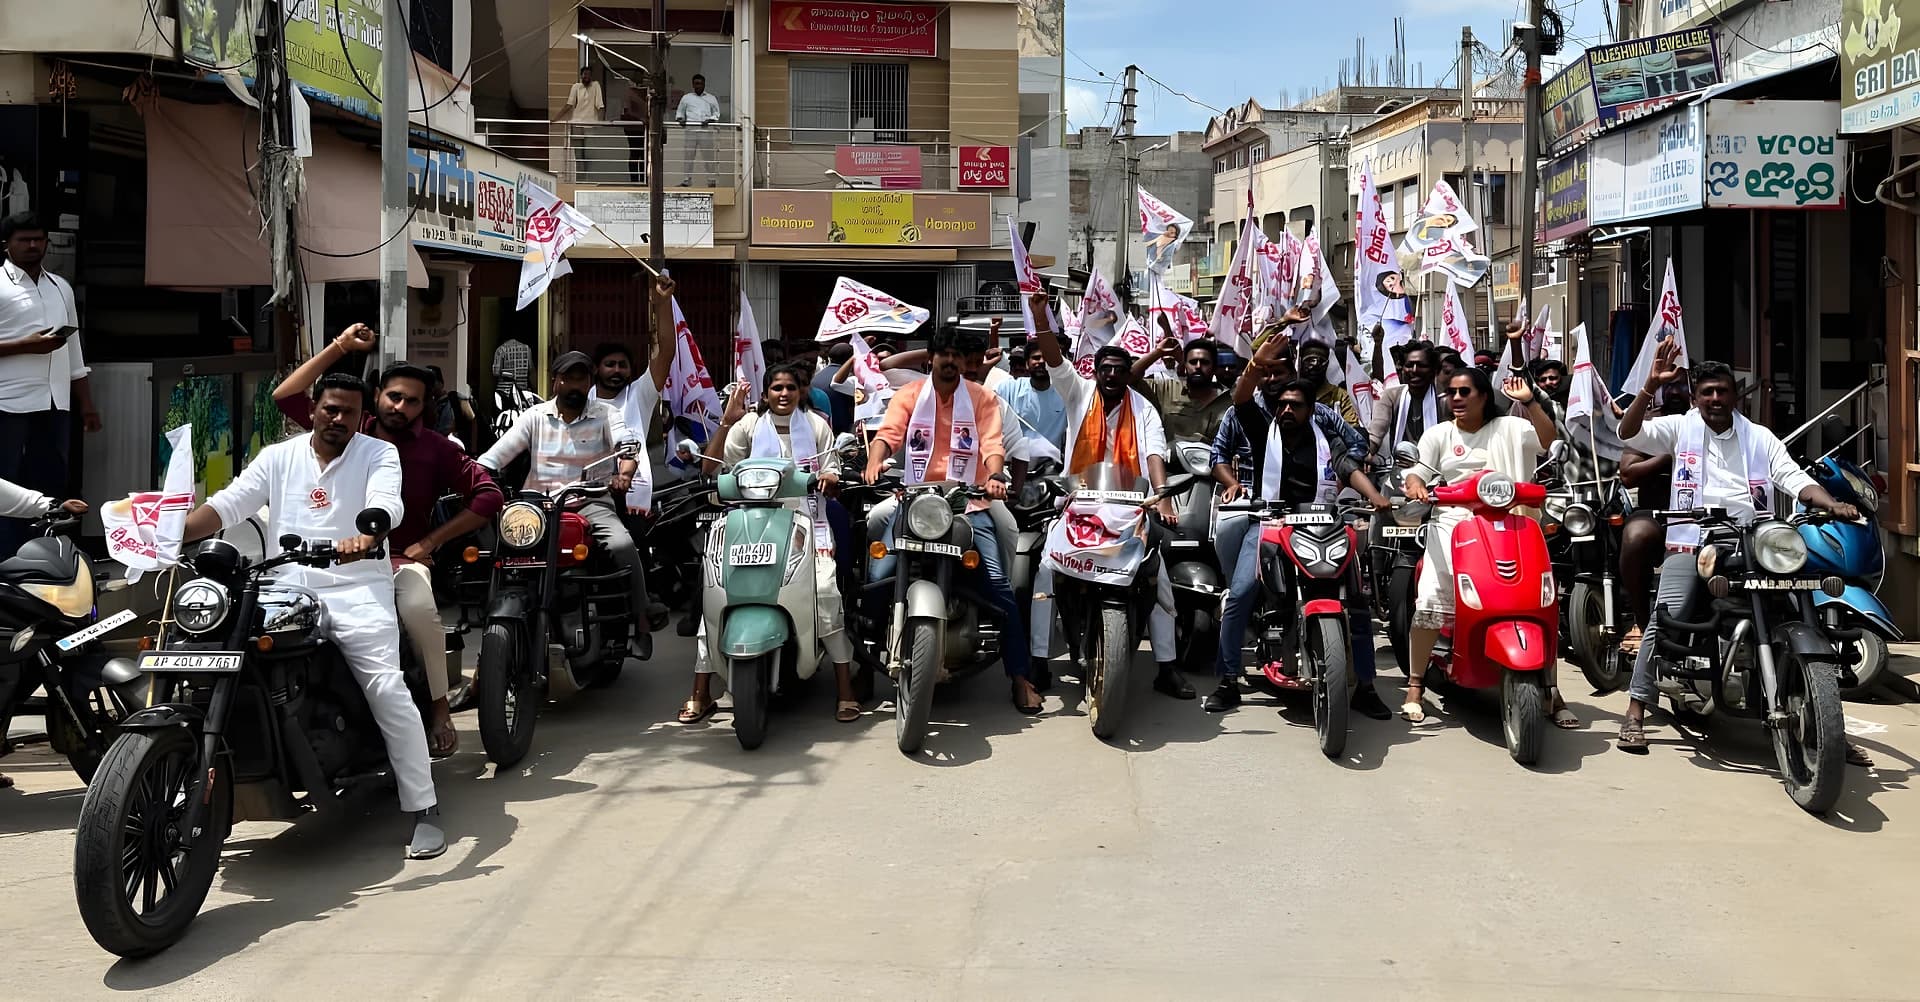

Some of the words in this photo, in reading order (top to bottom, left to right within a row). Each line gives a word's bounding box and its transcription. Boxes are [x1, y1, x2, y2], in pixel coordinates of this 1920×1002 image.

[1856, 61, 1886, 98] SRI
[1892, 50, 1920, 88] BA
[1757, 134, 1834, 156] ROJA
[1745, 161, 1835, 206] రోజా
